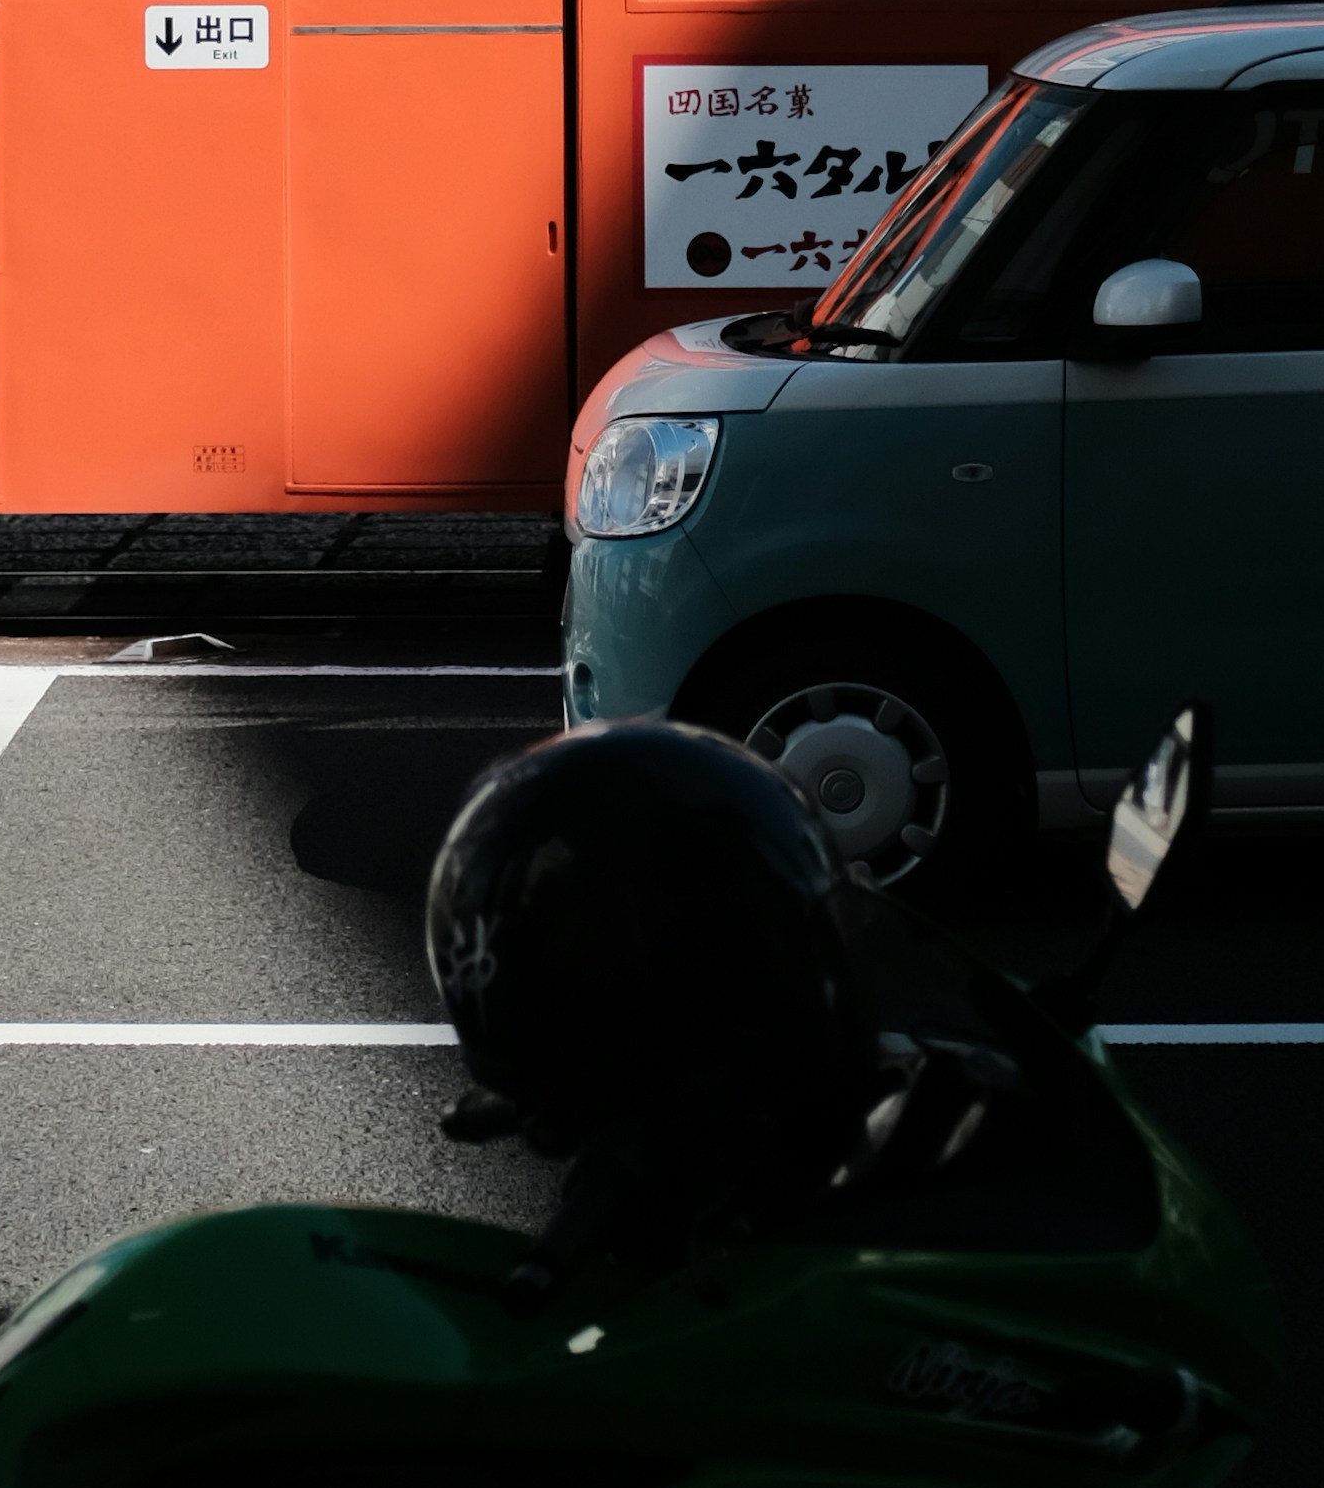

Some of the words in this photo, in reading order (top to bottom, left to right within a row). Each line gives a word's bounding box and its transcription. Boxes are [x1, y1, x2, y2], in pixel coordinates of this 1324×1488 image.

[196, 15, 254, 44] 出口
[213, 49, 238, 60] Exit
[667, 84, 816, 120] 四国名菓
[665, 139, 944, 200] 一六タル
